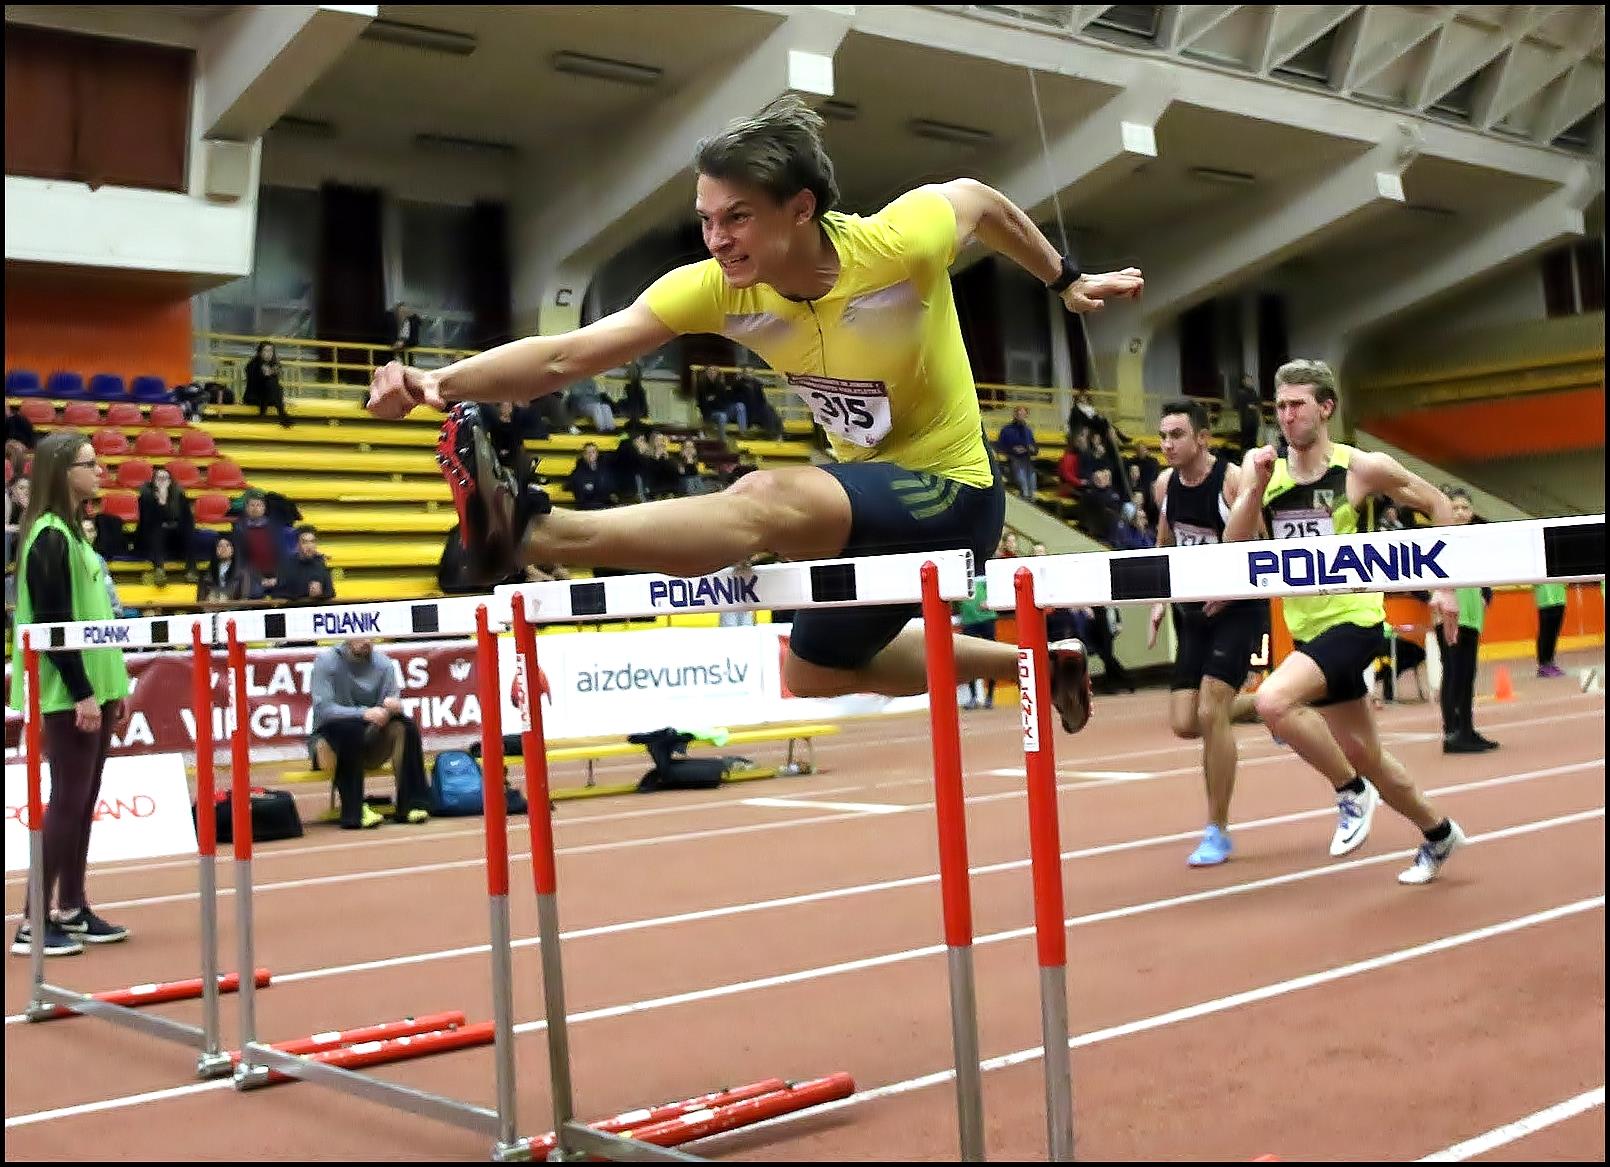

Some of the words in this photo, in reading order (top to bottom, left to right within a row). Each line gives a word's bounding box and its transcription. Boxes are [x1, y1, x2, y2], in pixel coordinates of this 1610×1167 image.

[811, 392, 875, 429] 315
[1283, 520, 1322, 539] 215
[1247, 539, 1450, 587] POLANIK
[649, 574, 760, 608] POLANIK
[83, 626, 131, 644] POLANIK
[313, 611, 381, 635] POLANIK
